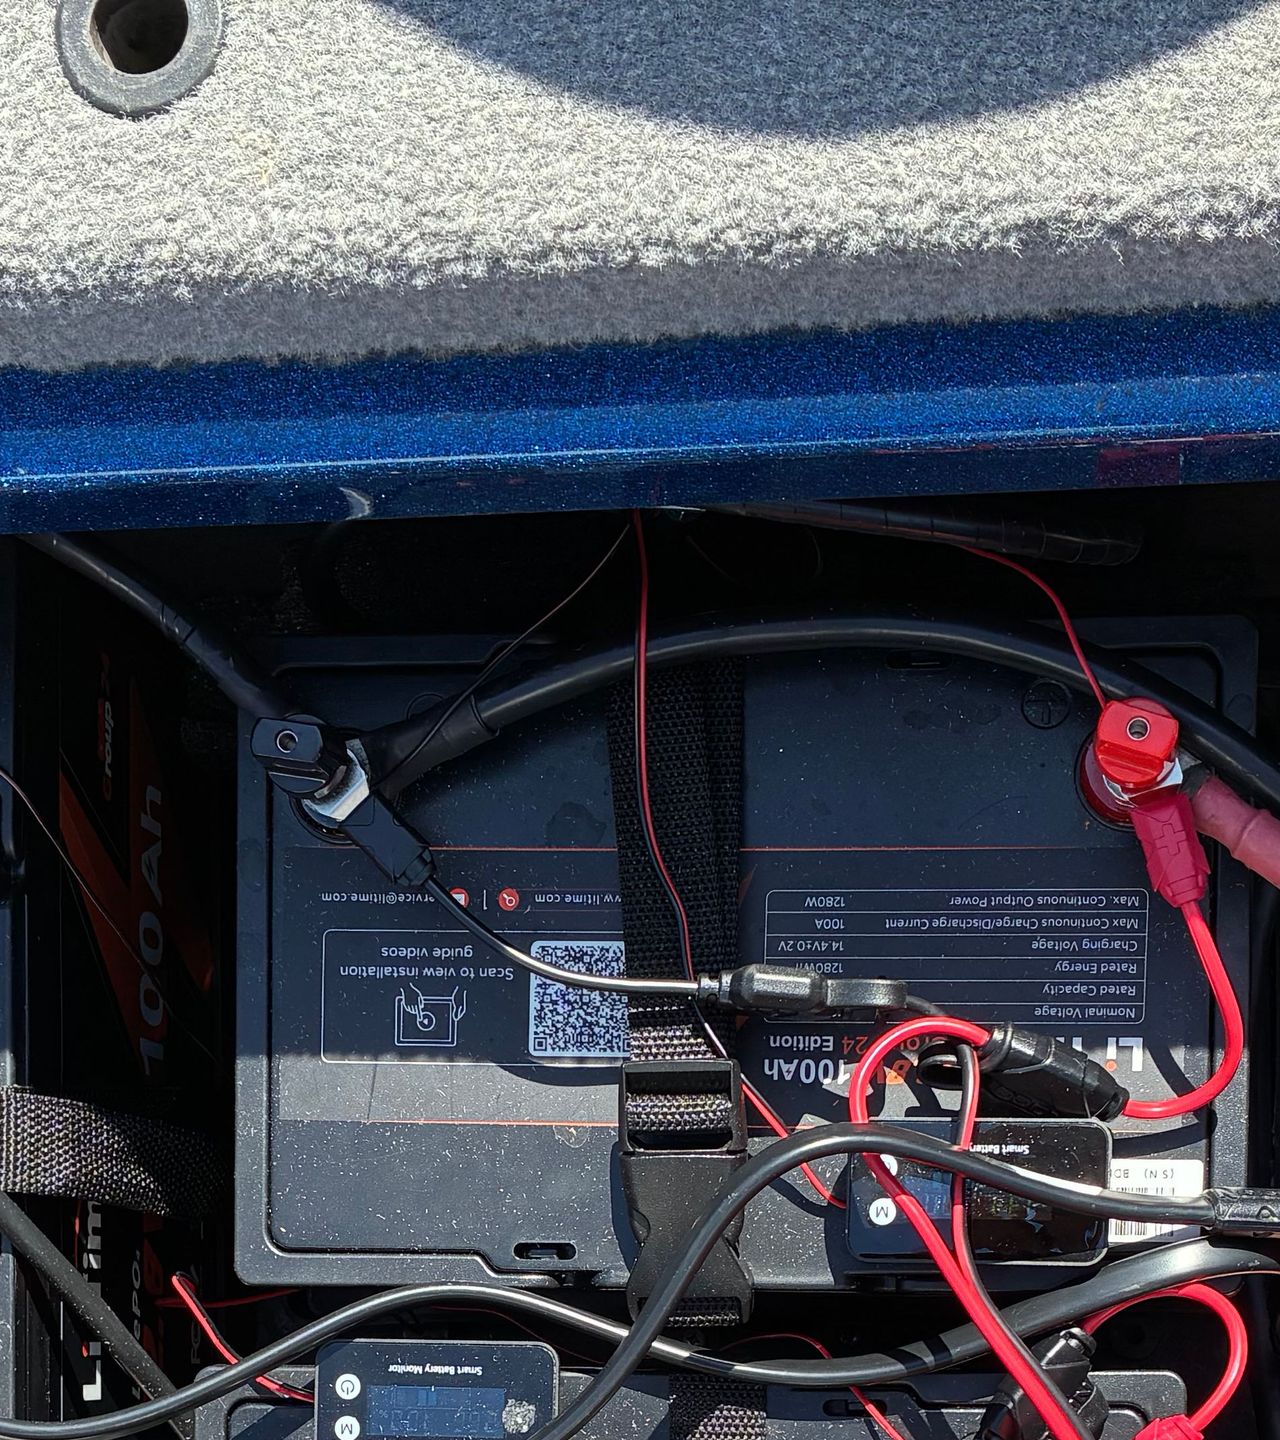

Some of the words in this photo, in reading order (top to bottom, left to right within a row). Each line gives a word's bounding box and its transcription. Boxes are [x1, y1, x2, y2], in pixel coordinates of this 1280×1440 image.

[321, 891, 435, 905] ervice@litime.com
[804, 896, 845, 907] 1280W
[949, 896, 988, 906] Power
[990, 894, 1033, 906] Output
[1036, 896, 1107, 906] Continuous
[814, 918, 845, 929] 100A
[885, 918, 929, 929] Current
[932, 916, 1039, 929] Charge/Discharge
[1041, 918, 1110, 929] Continuous
[1112, 918, 1139, 929] Max
[1031, 938, 1080, 952] Voltage
[1082, 938, 1138, 952] Charging
[381, 947, 428, 959] videos
[432, 945, 473, 959] guide
[340, 965, 419, 979] installation
[422, 966, 457, 979] view
[460, 966, 475, 979] to
[479, 966, 514, 980] Scan
[1054, 960, 1097, 973] Energy
[1099, 962, 1137, 973] Rated
[1042, 982, 1096, 996] Capacity
[1098, 984, 1137, 996] Rated
[1034, 1005, 1082, 1018] Voltage
[1085, 1007, 1136, 1018] Nominal
[770, 1035, 834, 1051] Edition
[1104, 1036, 1144, 1072] Li
[764, 1058, 850, 1084] 100Ah
[1001, 1144, 1030, 1155] Smart
[388, 1364, 423, 1375] Monitor
[424, 1363, 455, 1376] Battery
[457, 1365, 483, 1376] Smart
